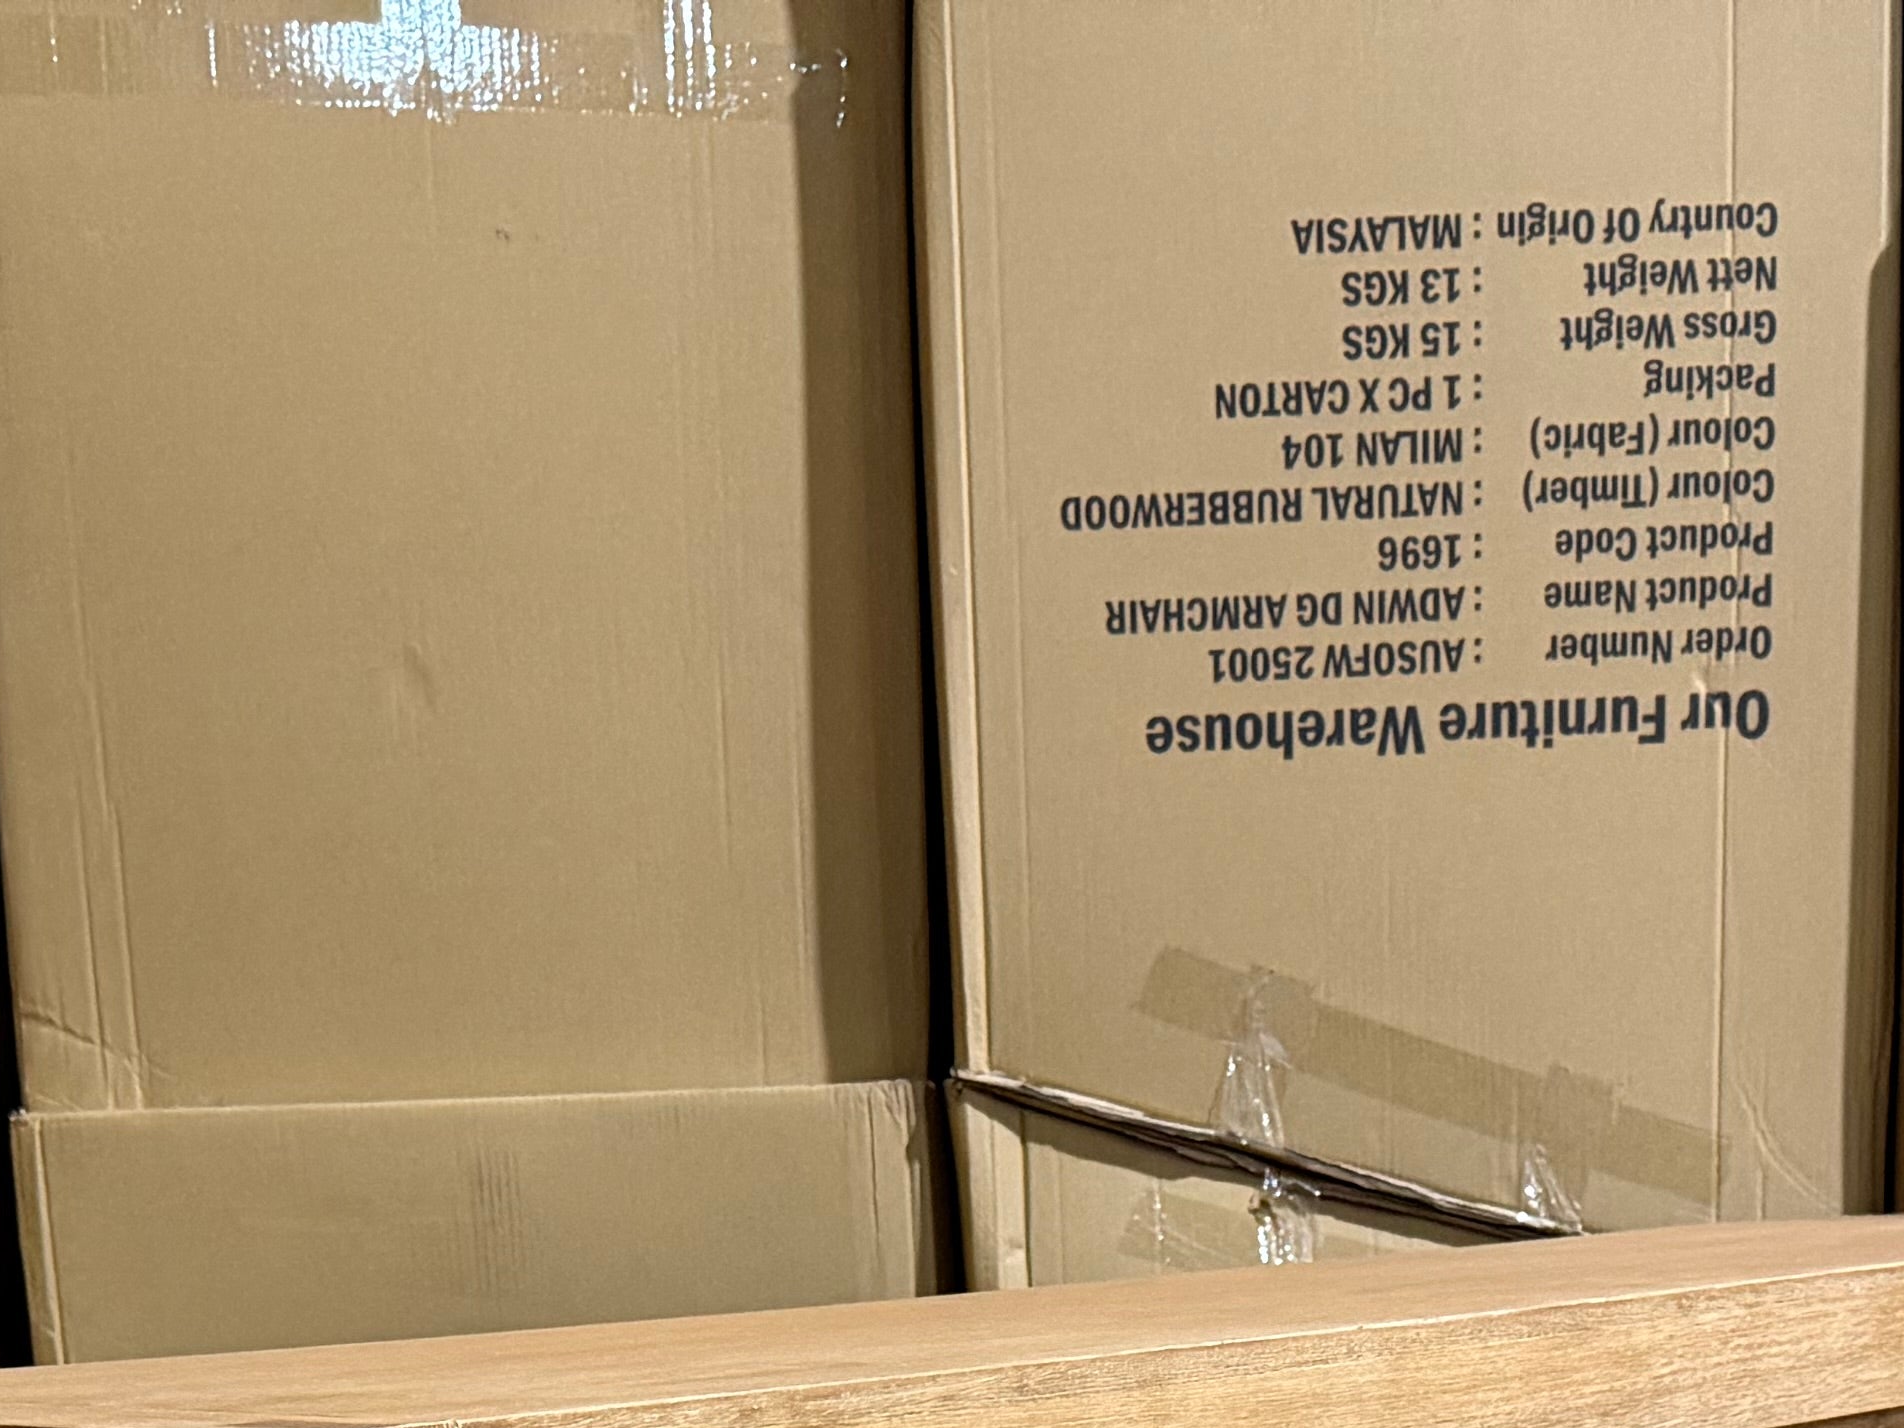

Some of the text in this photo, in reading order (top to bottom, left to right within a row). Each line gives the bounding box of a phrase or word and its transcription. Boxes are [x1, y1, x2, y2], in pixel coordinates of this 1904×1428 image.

[1290, 197, 1778, 255] Country Of Origin MALAYSIA
[1340, 252, 1777, 308] Nett Weight 13 KGS
[1341, 299, 1777, 361] Gross Weight 15 KGS
[1215, 358, 1776, 420] Packing 1 PC X CARTON
[1281, 412, 1776, 471] Colour (Fabric) MILAN 104
[1060, 458, 1775, 531] Colour (Timber) NATURAL RUBBERWOOD
[1377, 520, 1774, 572] Product Code 1696
[1104, 572, 1773, 635] Product Name ADWIN DG ARMCHAIR
[1207, 624, 1772, 684] Order Number AUSOFW 25001
[1145, 688, 1770, 761] Our Furniture Warehouse
